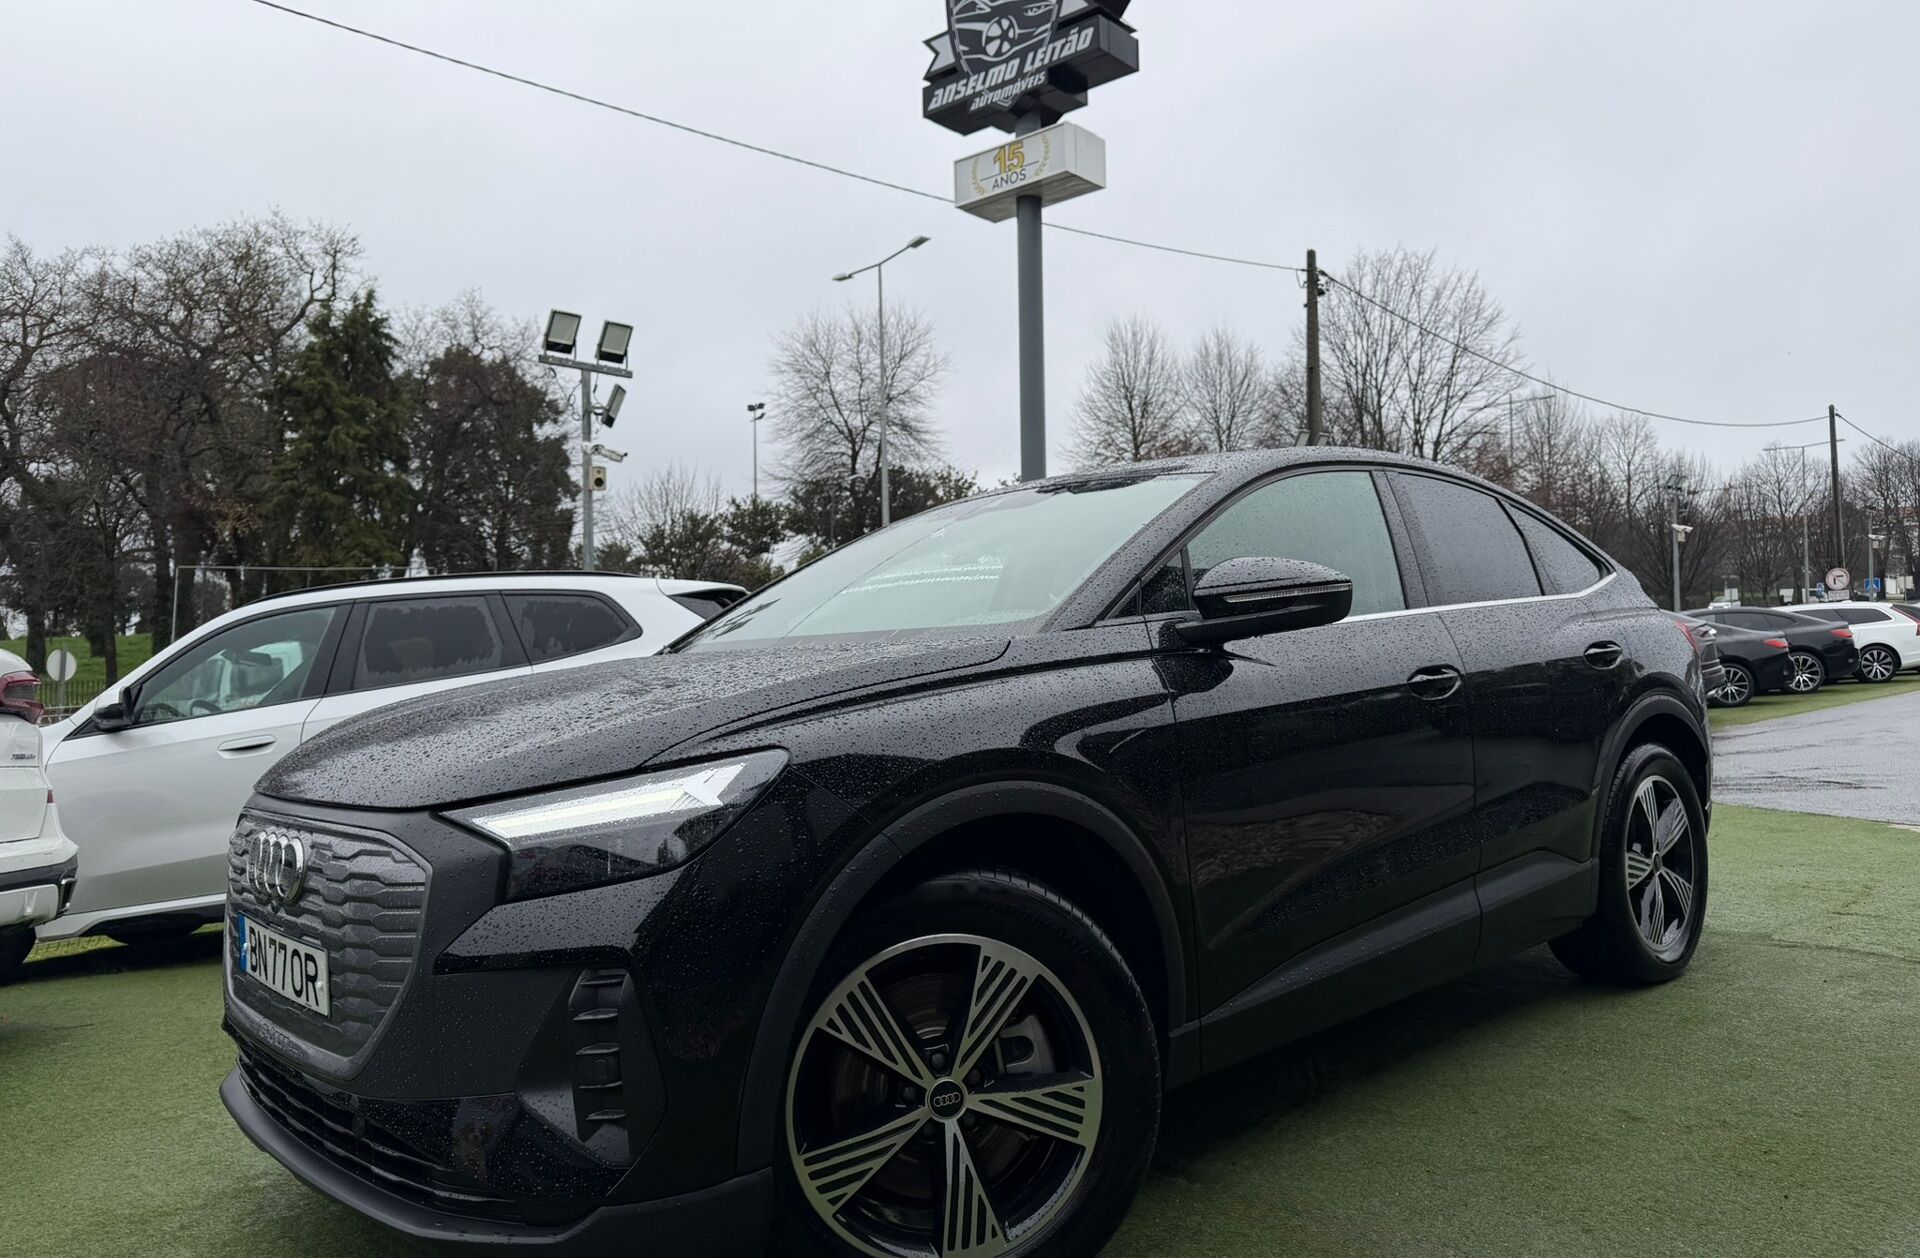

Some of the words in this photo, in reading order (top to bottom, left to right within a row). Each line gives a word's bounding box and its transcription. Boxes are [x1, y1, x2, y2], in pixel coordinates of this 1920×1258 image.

[1023, 27, 1094, 73] LEITÃO
[993, 141, 1024, 174] 15
[992, 169, 1026, 190] ANOS
